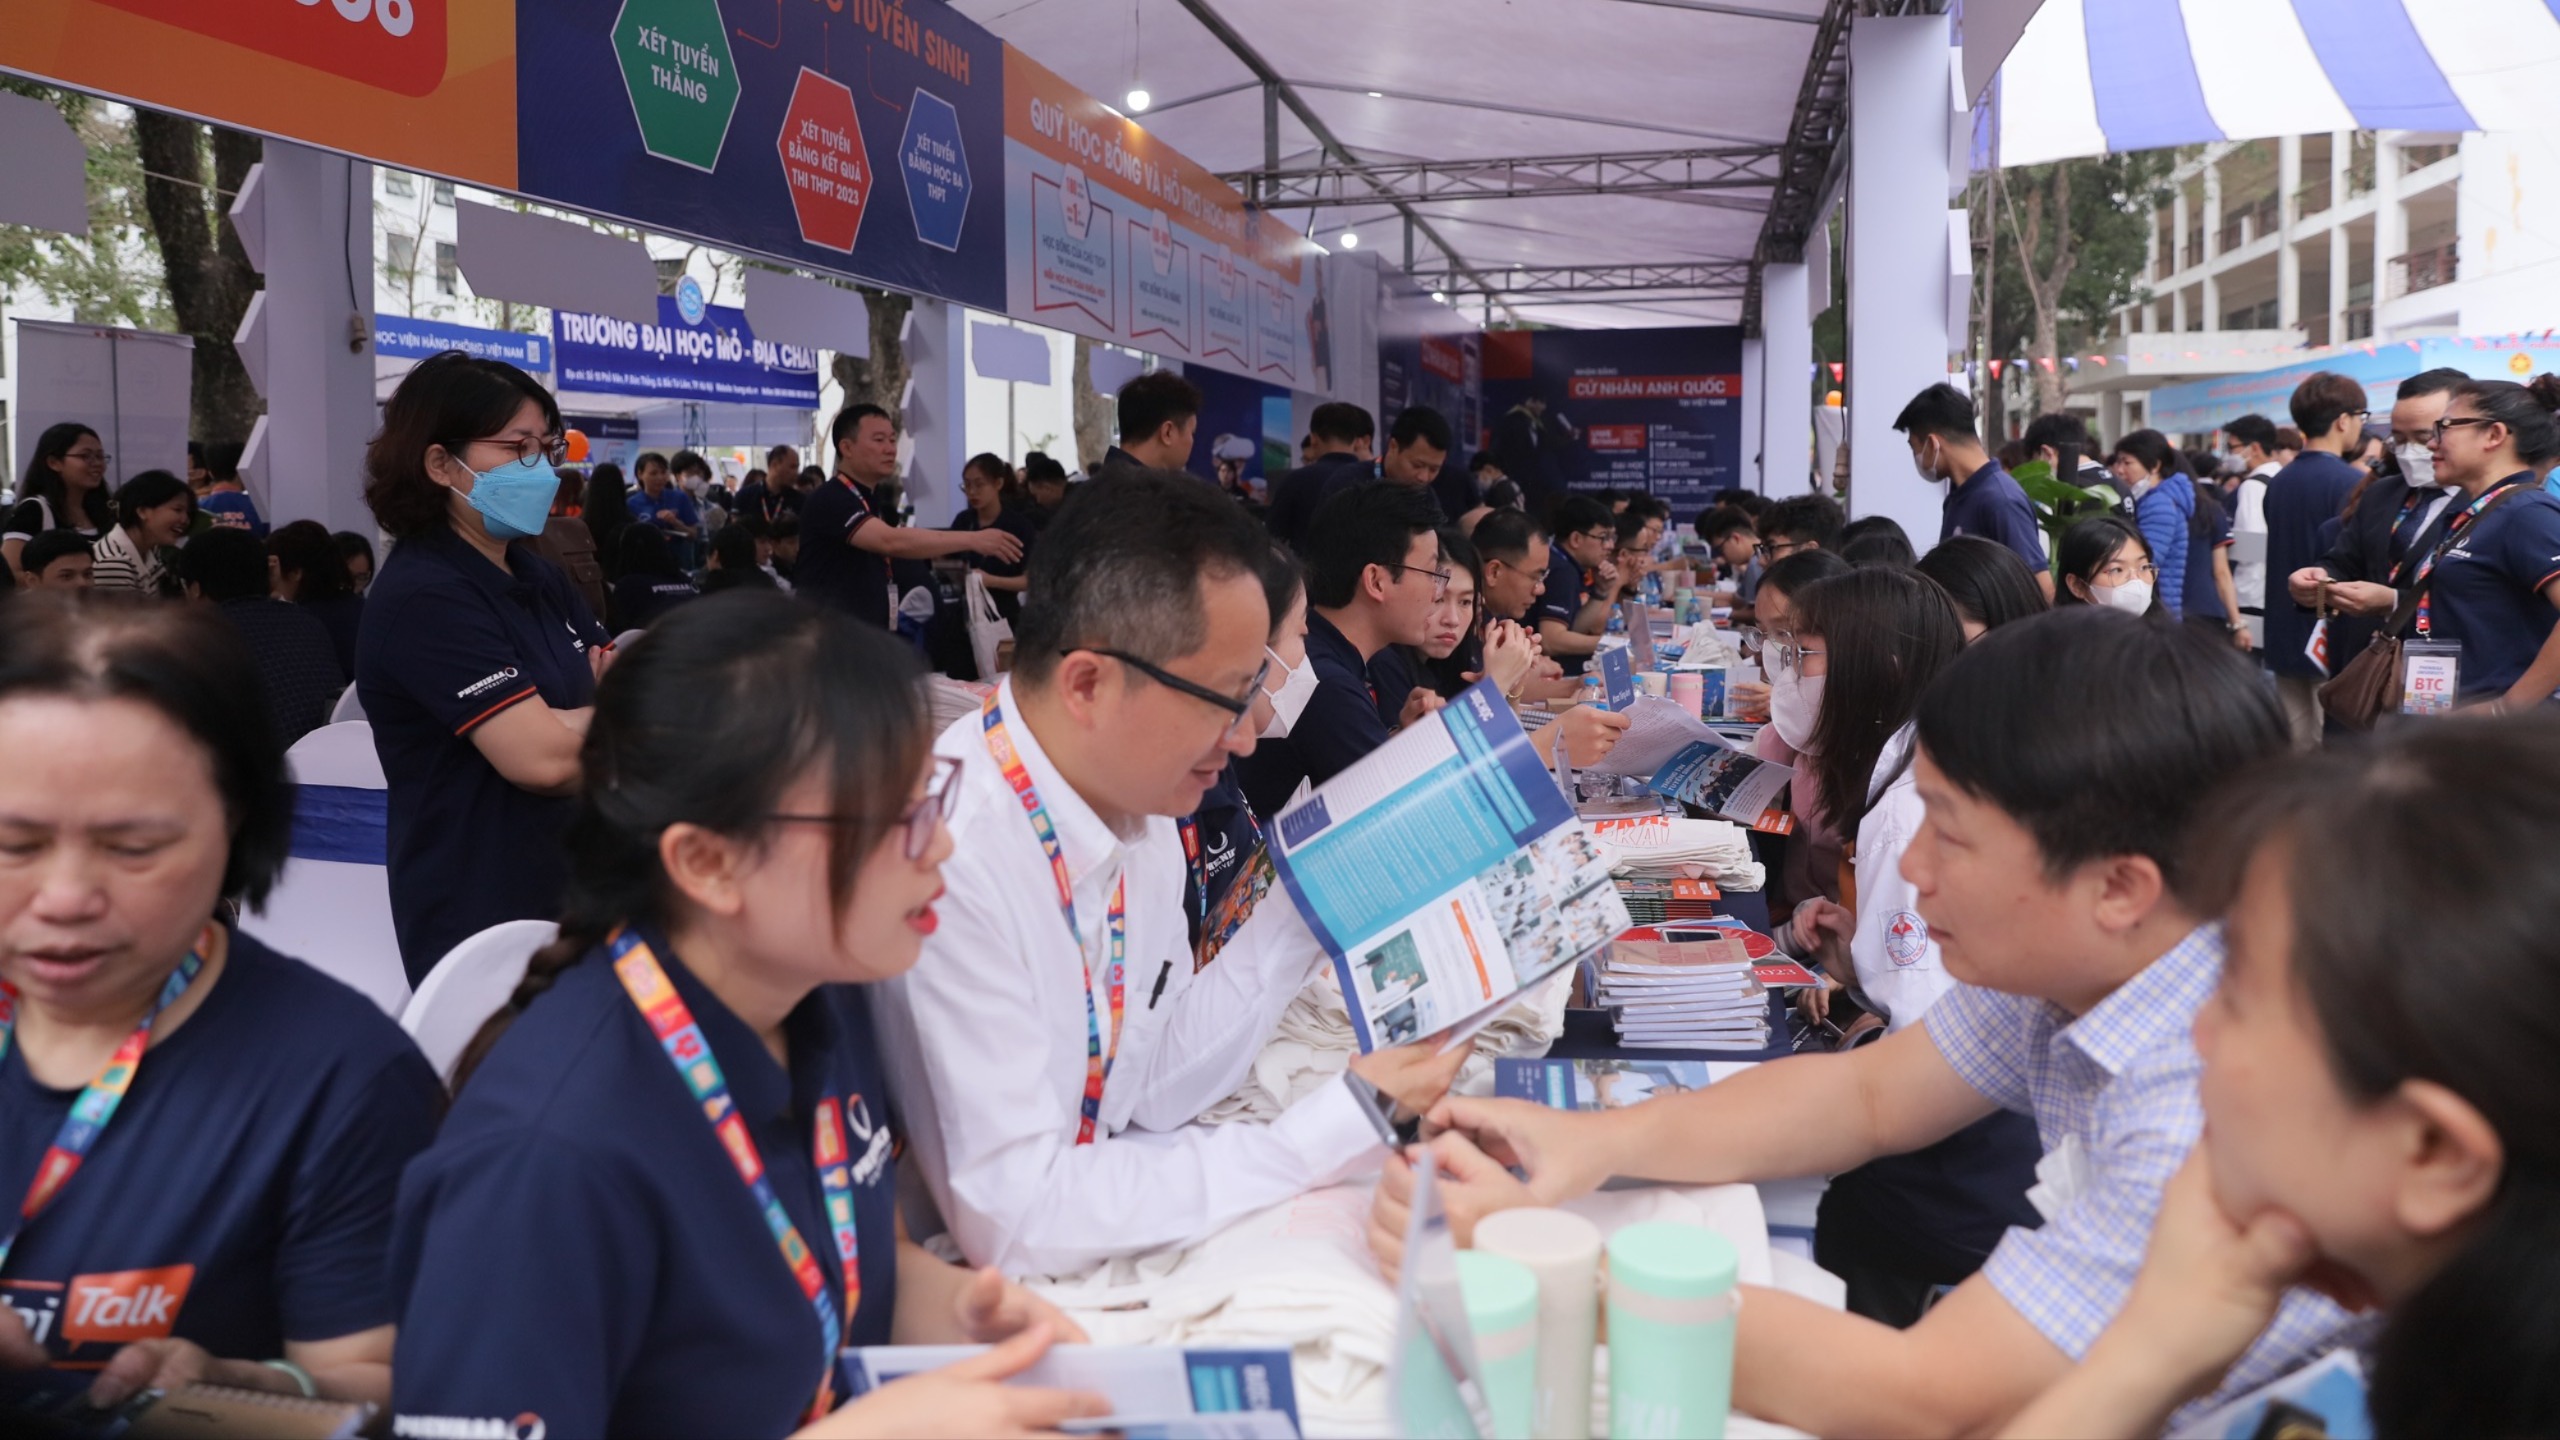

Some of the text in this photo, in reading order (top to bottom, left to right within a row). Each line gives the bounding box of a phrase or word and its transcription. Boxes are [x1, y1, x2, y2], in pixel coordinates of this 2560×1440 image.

[637, 25, 719, 78] XÉT TUYỂN
[925, 29, 970, 86] SINH
[801, 120, 851, 155] XÉT TUYỂN
[917, 133, 956, 163] XÉT TUYỂN
[1032, 97, 1064, 142] QUỸ
[1068, 119, 1101, 165] HỌC
[1104, 131, 1142, 186] BỔNG
[1144, 160, 1162, 197] VÀ
[1162, 168, 1180, 206] HỖ
[789, 138, 862, 183] BẰNG KẾT QUẢ
[908, 150, 932, 176] BẰNG
[933, 165, 952, 188] HỌC
[792, 168, 860, 206] THI THPT 2023
[928, 182, 946, 203] THPT
[375, 331, 396, 346] HỌC
[398, 332, 420, 348] VIỆN
[422, 332, 450, 350] HÀNG
[485, 343, 503, 357] VIỆT
[504, 346, 525, 359] NAM
[641, 323, 673, 361] ĐẠI
[675, 329, 713, 364] HỌC
[716, 328, 743, 361] MỎ
[753, 339, 779, 371] ĐỊA
[1575, 376, 1726, 395] CỬ NHÂN ANH QUỐC
[457, 671, 506, 698] PHENIKAA
[473, 677, 508, 696] UNIVERSITY
[2415, 677, 2444, 691] BTC
[1754, 967, 1797, 976] 2023
[73, 1282, 174, 1327] Talk
